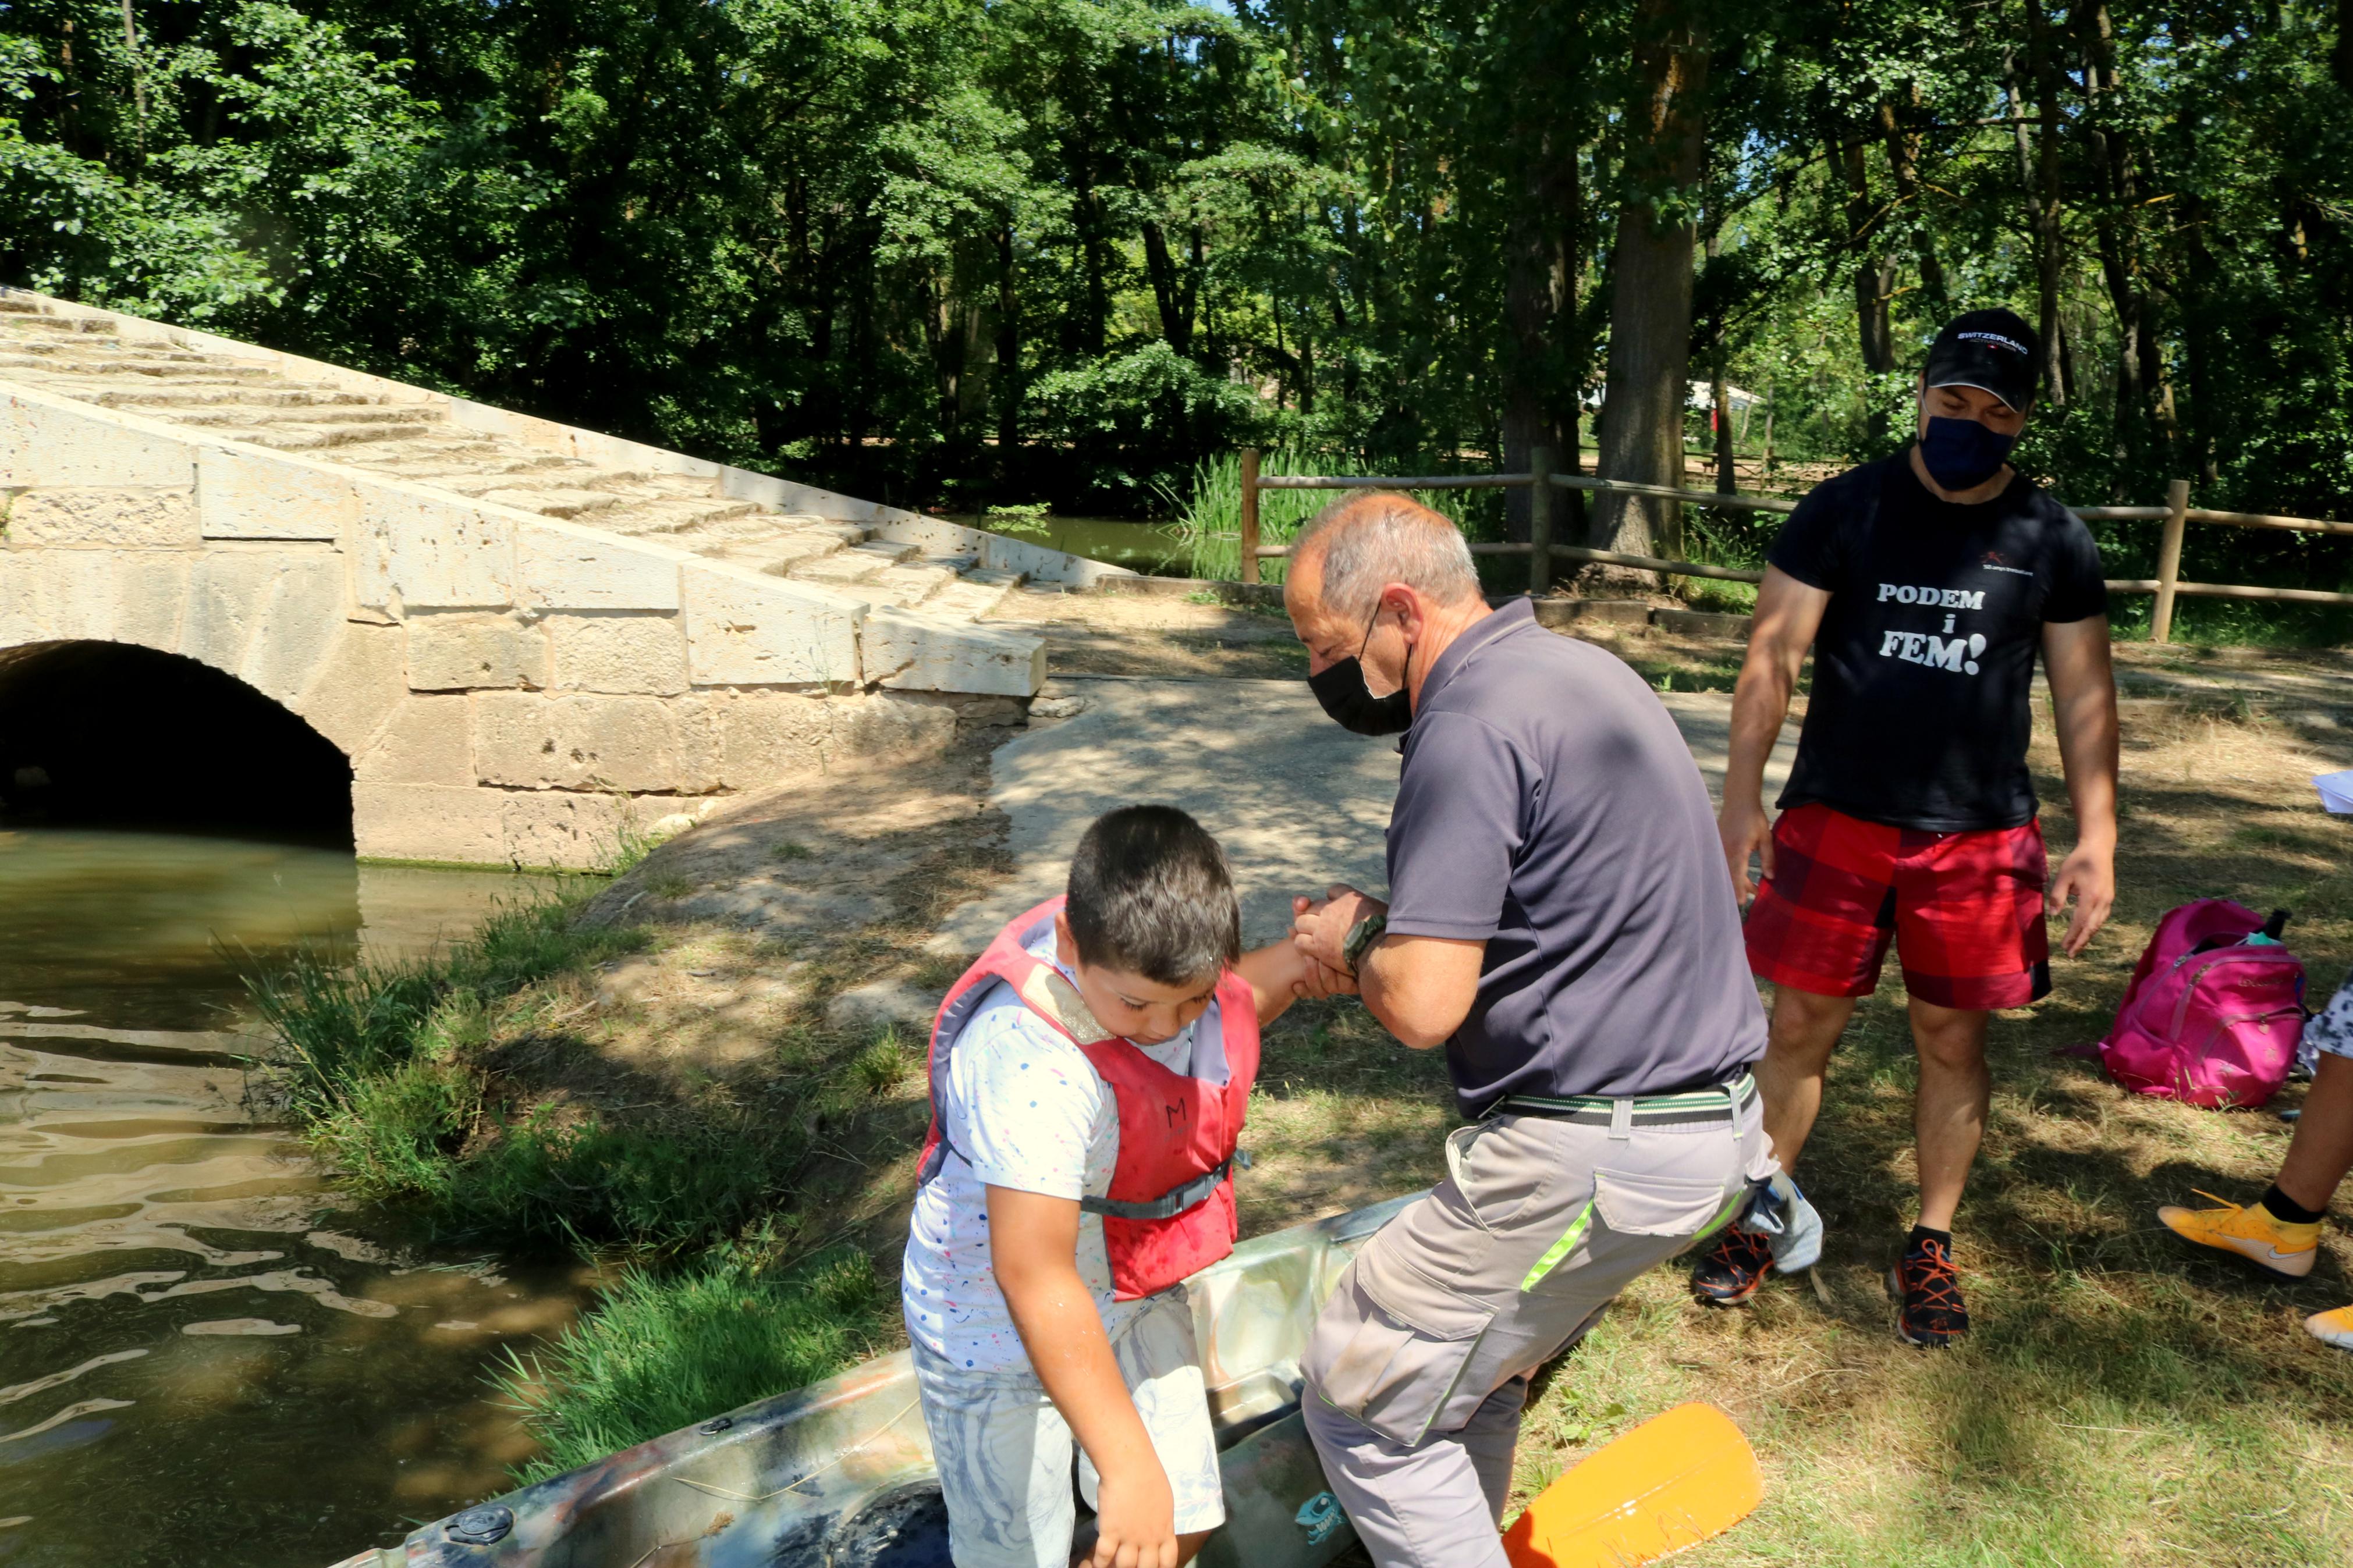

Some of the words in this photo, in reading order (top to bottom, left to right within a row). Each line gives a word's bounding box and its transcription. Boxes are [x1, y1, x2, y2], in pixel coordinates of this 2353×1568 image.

[1957, 332, 2028, 355] SWITZERLAND
[1877, 584, 1986, 610] PODEM
[1942, 614, 1955, 634] i
[1879, 631, 1986, 675] FEM!
[1166, 1097, 1186, 1128] M
